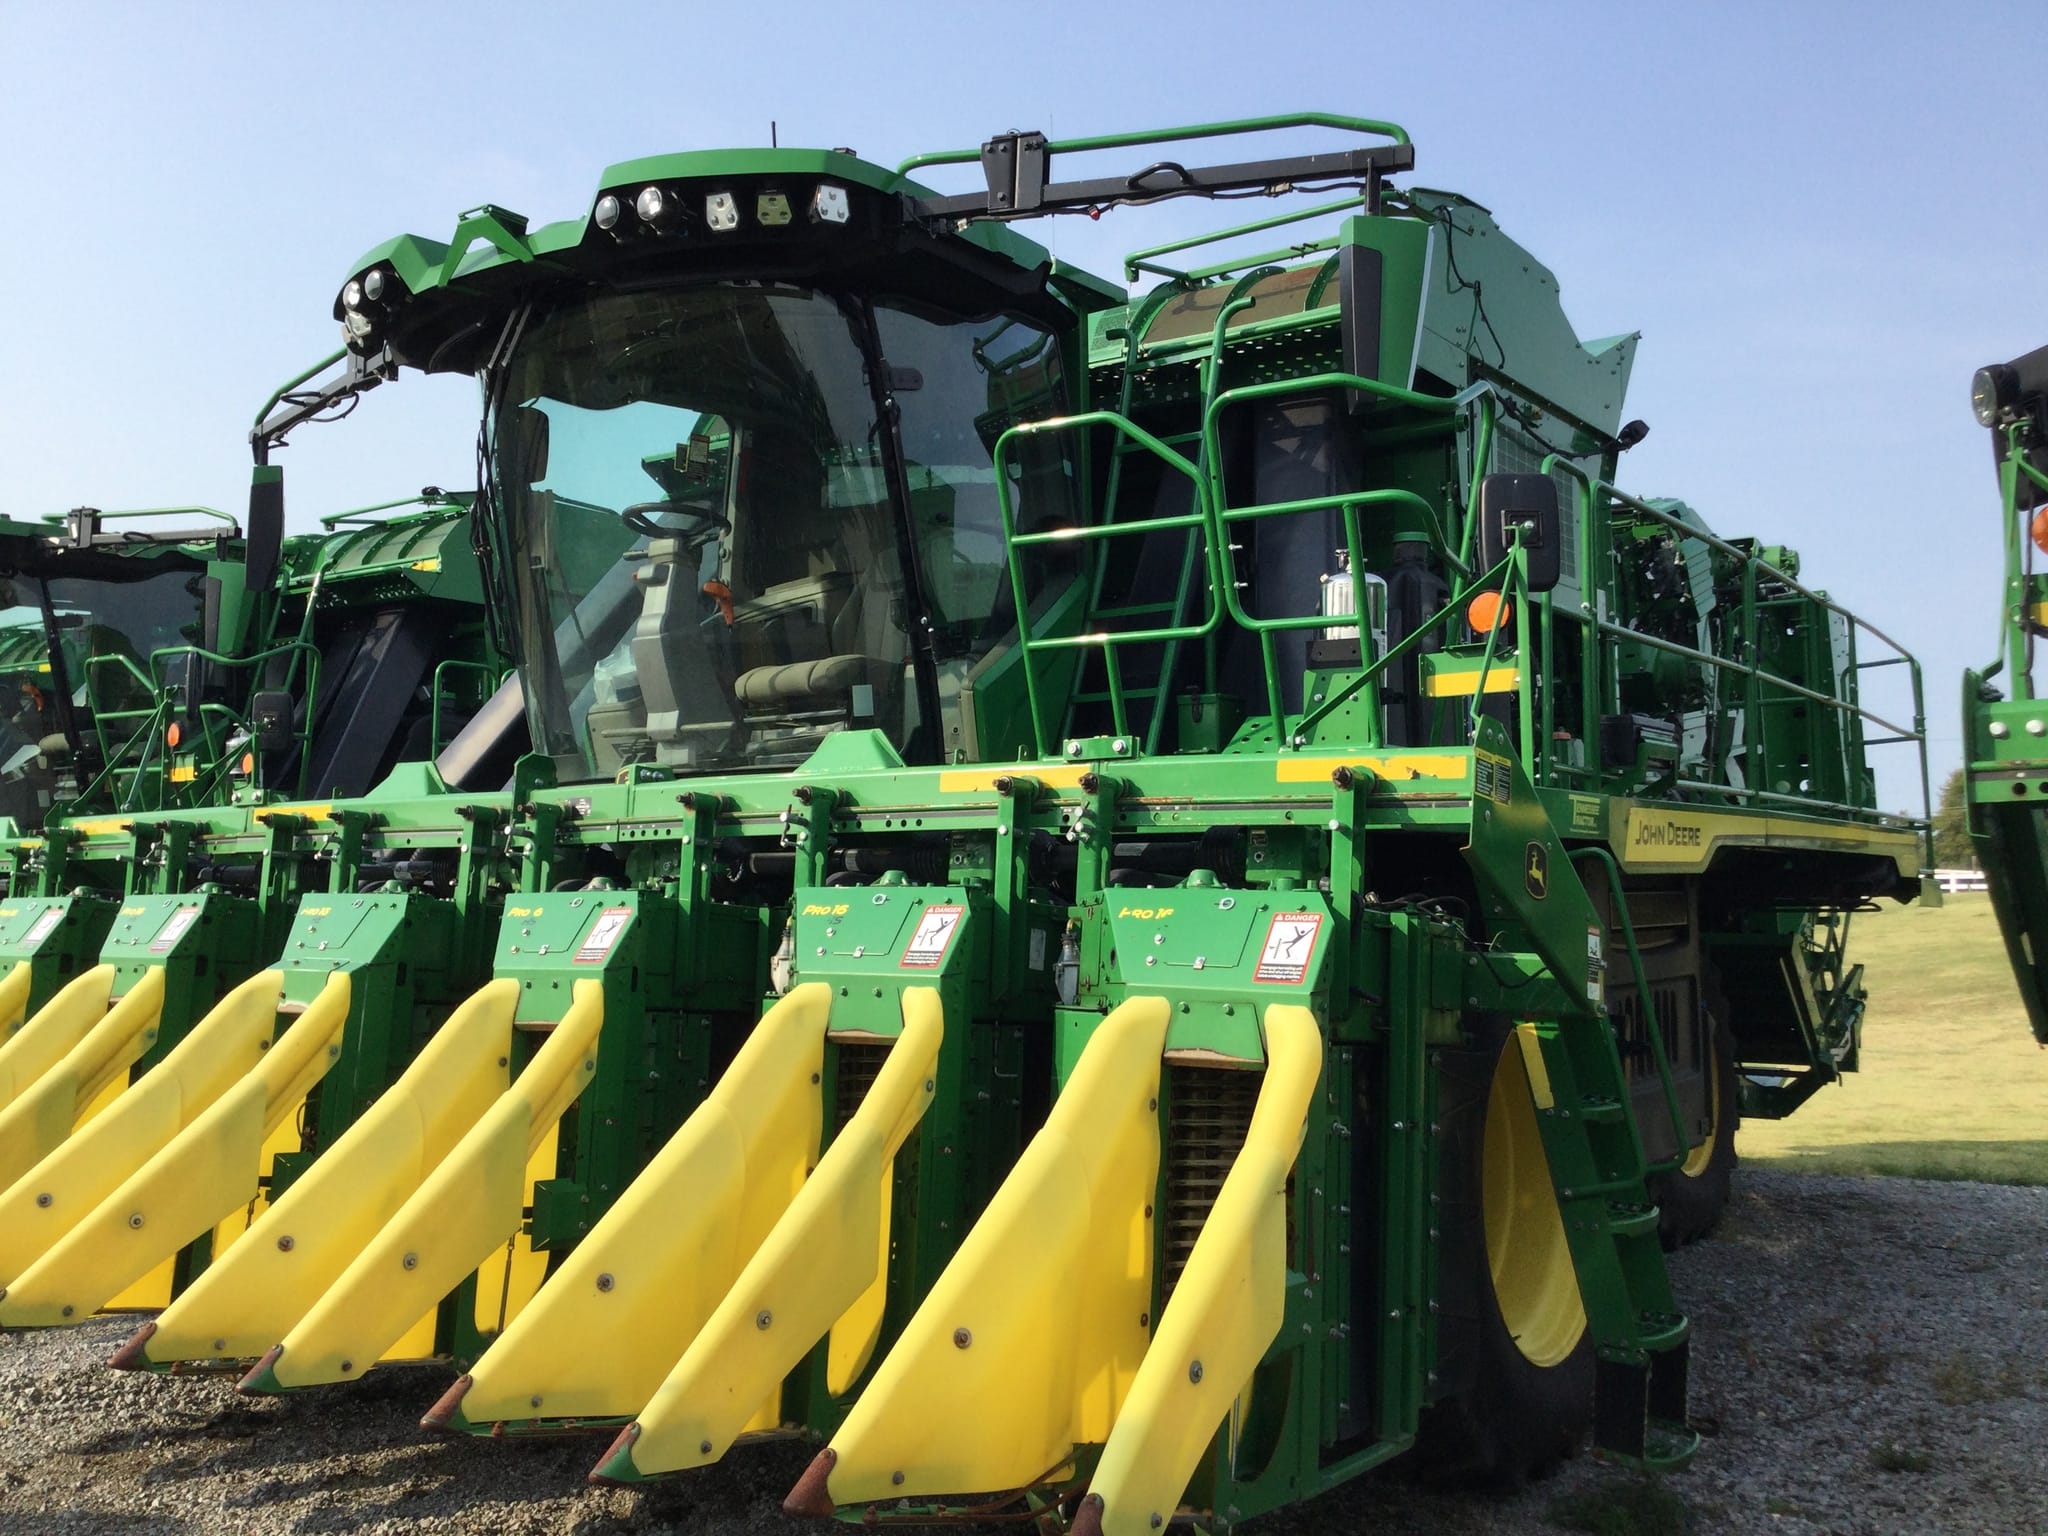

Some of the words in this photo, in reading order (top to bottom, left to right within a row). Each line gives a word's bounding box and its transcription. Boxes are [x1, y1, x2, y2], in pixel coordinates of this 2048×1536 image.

[1635, 820, 1665, 846] JOHN
[1667, 821, 1701, 847] DEERE
[507, 907, 531, 917] PRO
[802, 905, 831, 916] PRO
[831, 903, 850, 915] 16
